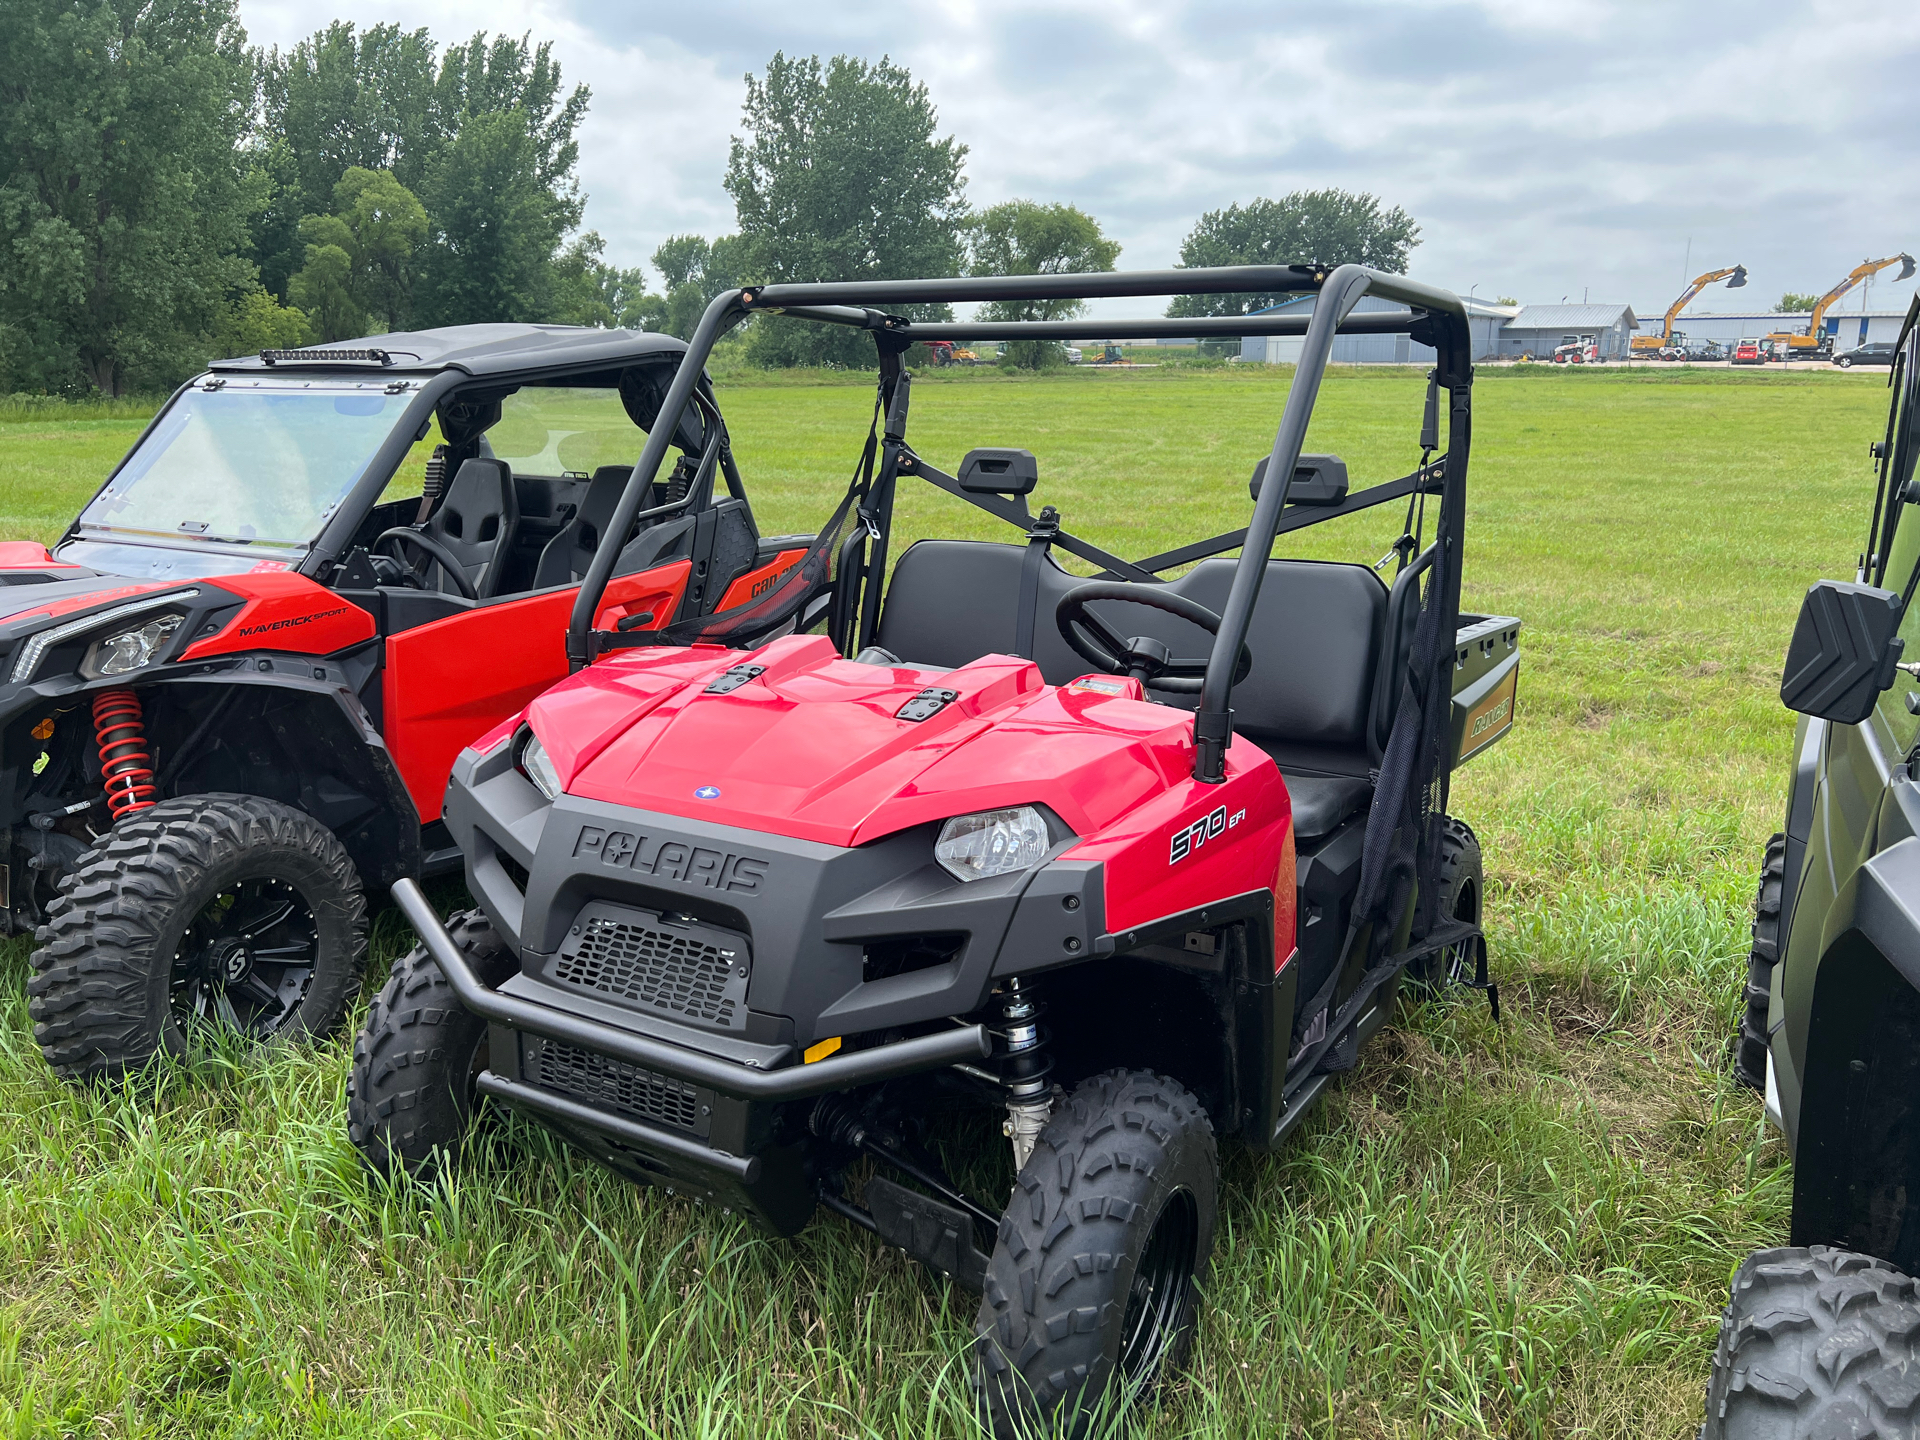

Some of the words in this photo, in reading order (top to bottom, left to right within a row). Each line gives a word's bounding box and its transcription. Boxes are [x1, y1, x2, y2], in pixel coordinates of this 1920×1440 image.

[239, 614, 314, 637] MAVERICK
[313, 607, 349, 621] SPORT
[571, 825, 770, 897] POLARIS
[1169, 804, 1226, 866] 570
[1229, 808, 1246, 829] EFI
